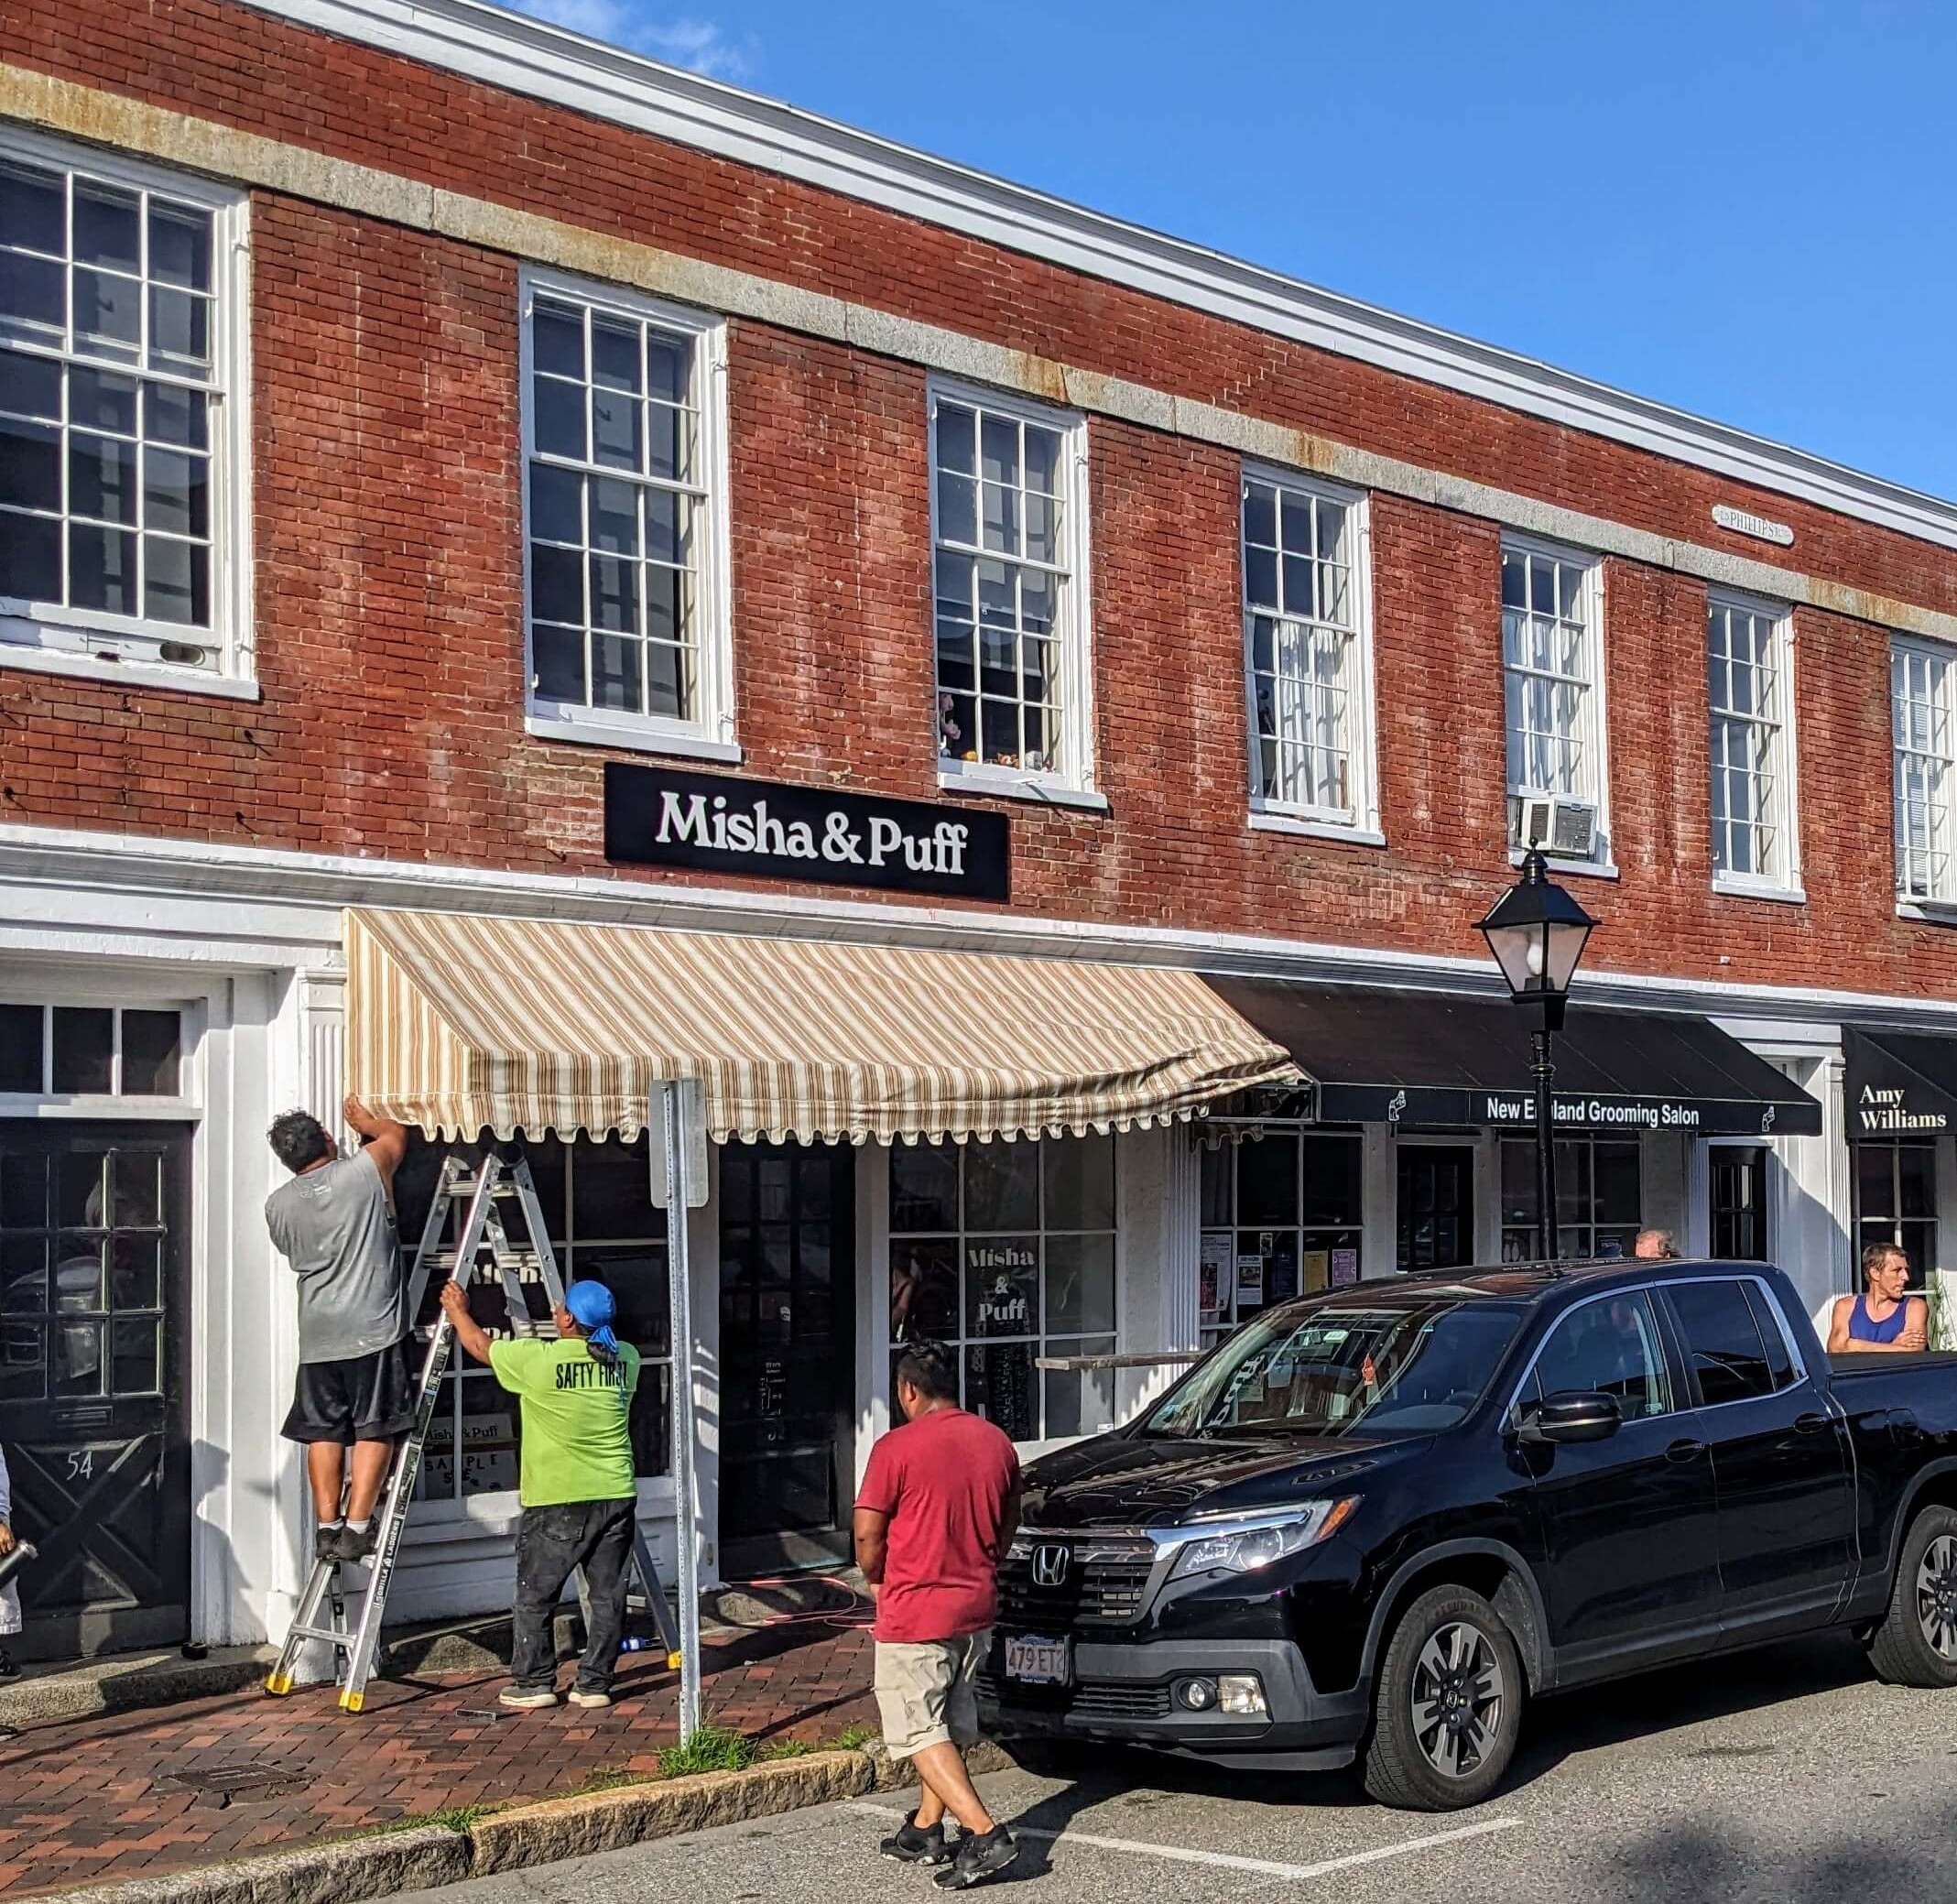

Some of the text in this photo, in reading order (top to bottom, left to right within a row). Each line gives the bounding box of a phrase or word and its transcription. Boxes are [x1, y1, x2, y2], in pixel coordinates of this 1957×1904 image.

[1730, 511, 1774, 538] PHILLIPS
[1859, 1084, 1905, 1108] Amy
[1487, 1097, 1700, 1128] New Eland Grooming Salon
[1859, 1109, 1947, 1130] Williams
[968, 1248, 1035, 1268] Misha
[995, 1276, 1008, 1294] &
[979, 1299, 1026, 1322] Puff
[556, 1361, 594, 1390] SAFTY
[424, 1428, 456, 1441] Mish
[472, 1425, 498, 1437] Puff
[66, 1451, 92, 1481] 54
[424, 1453, 498, 1472] SAPLE
